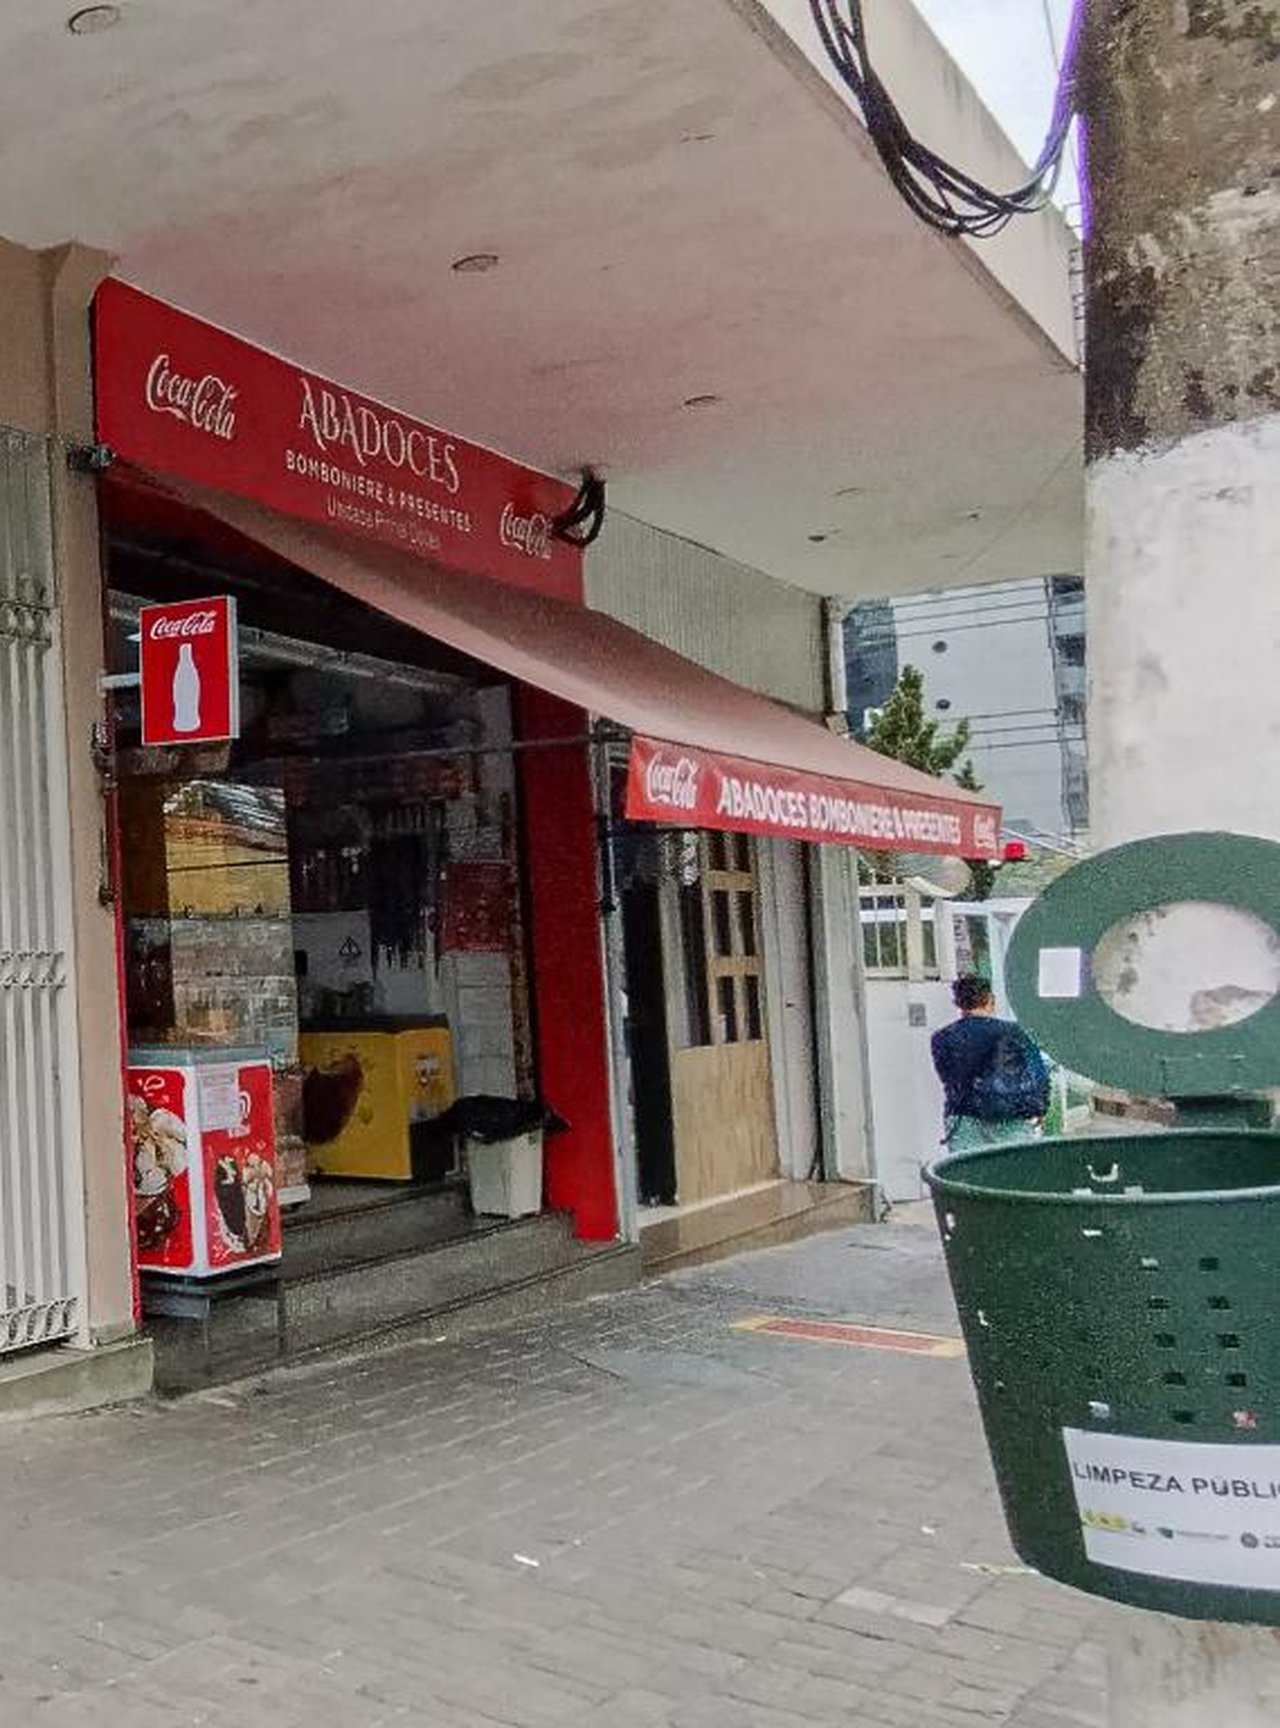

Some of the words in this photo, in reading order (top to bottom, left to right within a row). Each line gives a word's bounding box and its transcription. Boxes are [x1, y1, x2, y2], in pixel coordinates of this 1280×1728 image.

[146, 354, 239, 440] Coca-Cola
[300, 377, 460, 494] ABADOCES
[286, 448, 384, 503] BOMBONIERE
[150, 610, 218, 640] Coca-Cola
[716, 776, 808, 829] ABADOCES
[809, 794, 895, 840] BOMBONIERE
[1073, 1461, 1185, 1494] LIMPEZA
